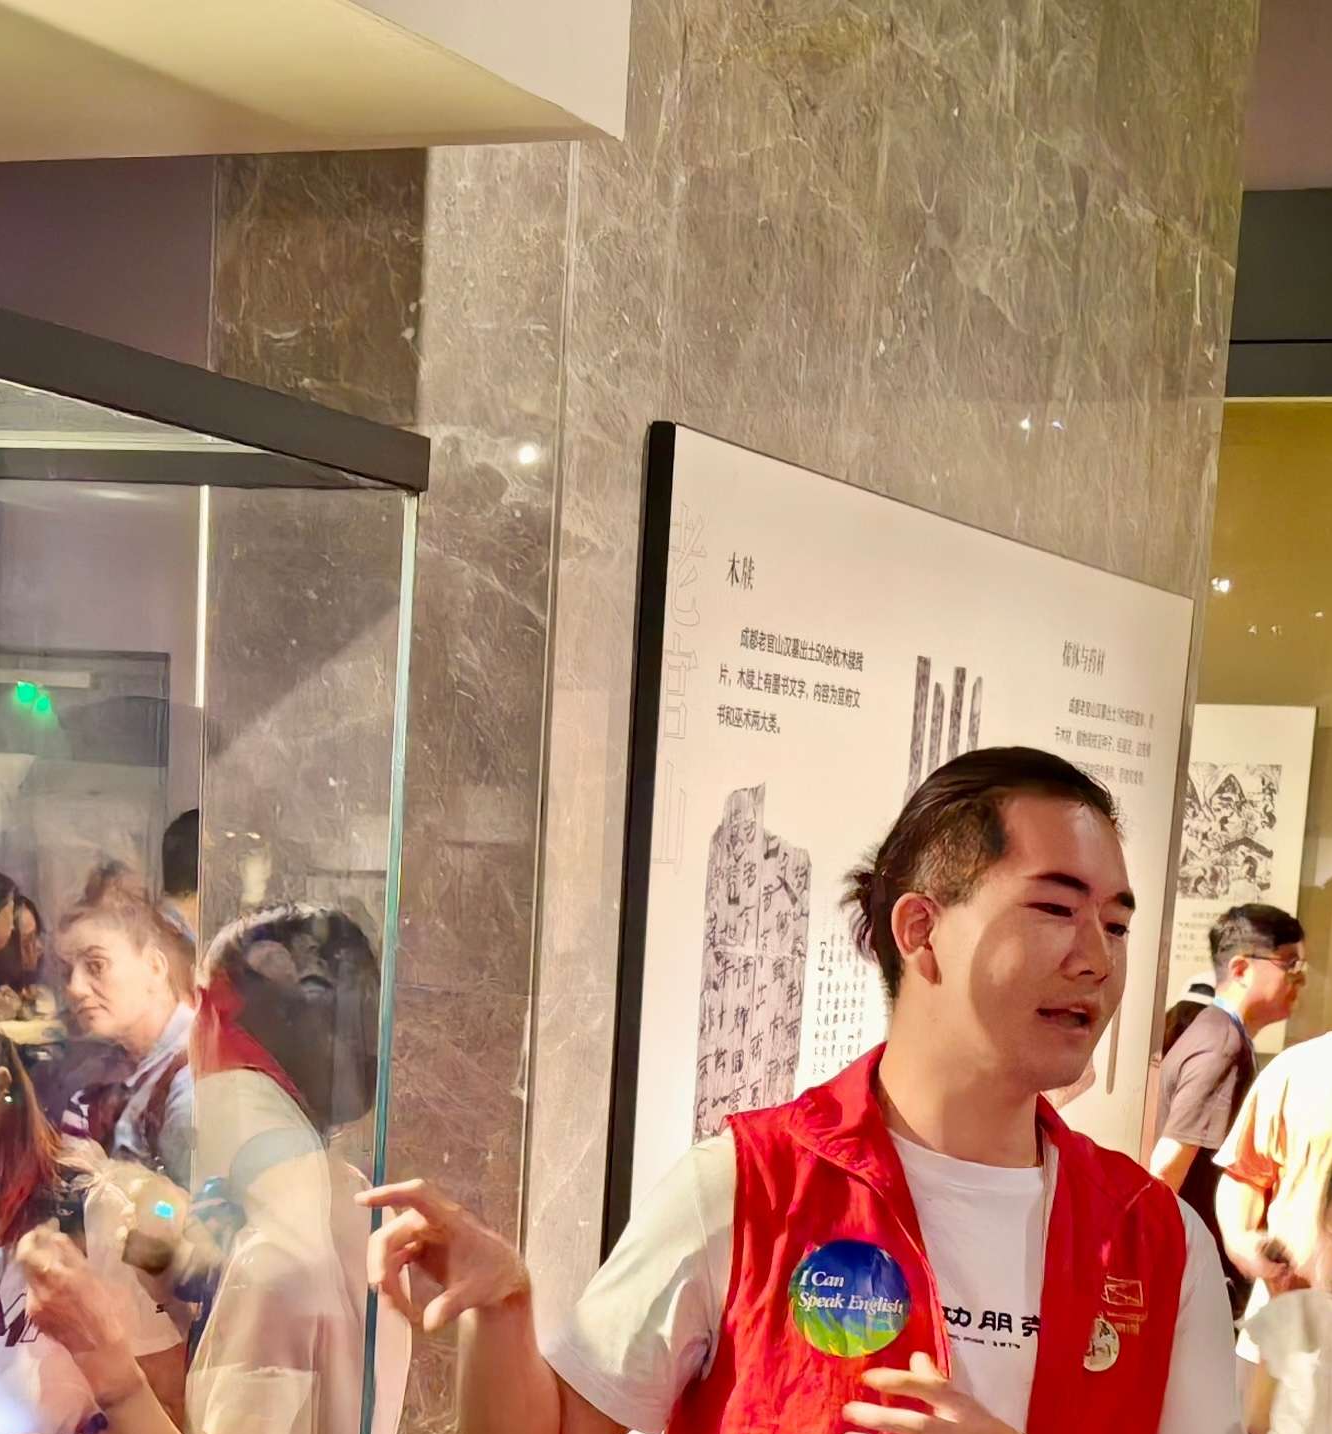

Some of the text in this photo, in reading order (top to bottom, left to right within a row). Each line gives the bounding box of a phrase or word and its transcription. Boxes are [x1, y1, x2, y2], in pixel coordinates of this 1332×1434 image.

[811, 1271, 845, 1288] Can
[799, 1291, 904, 1316] Speak English
